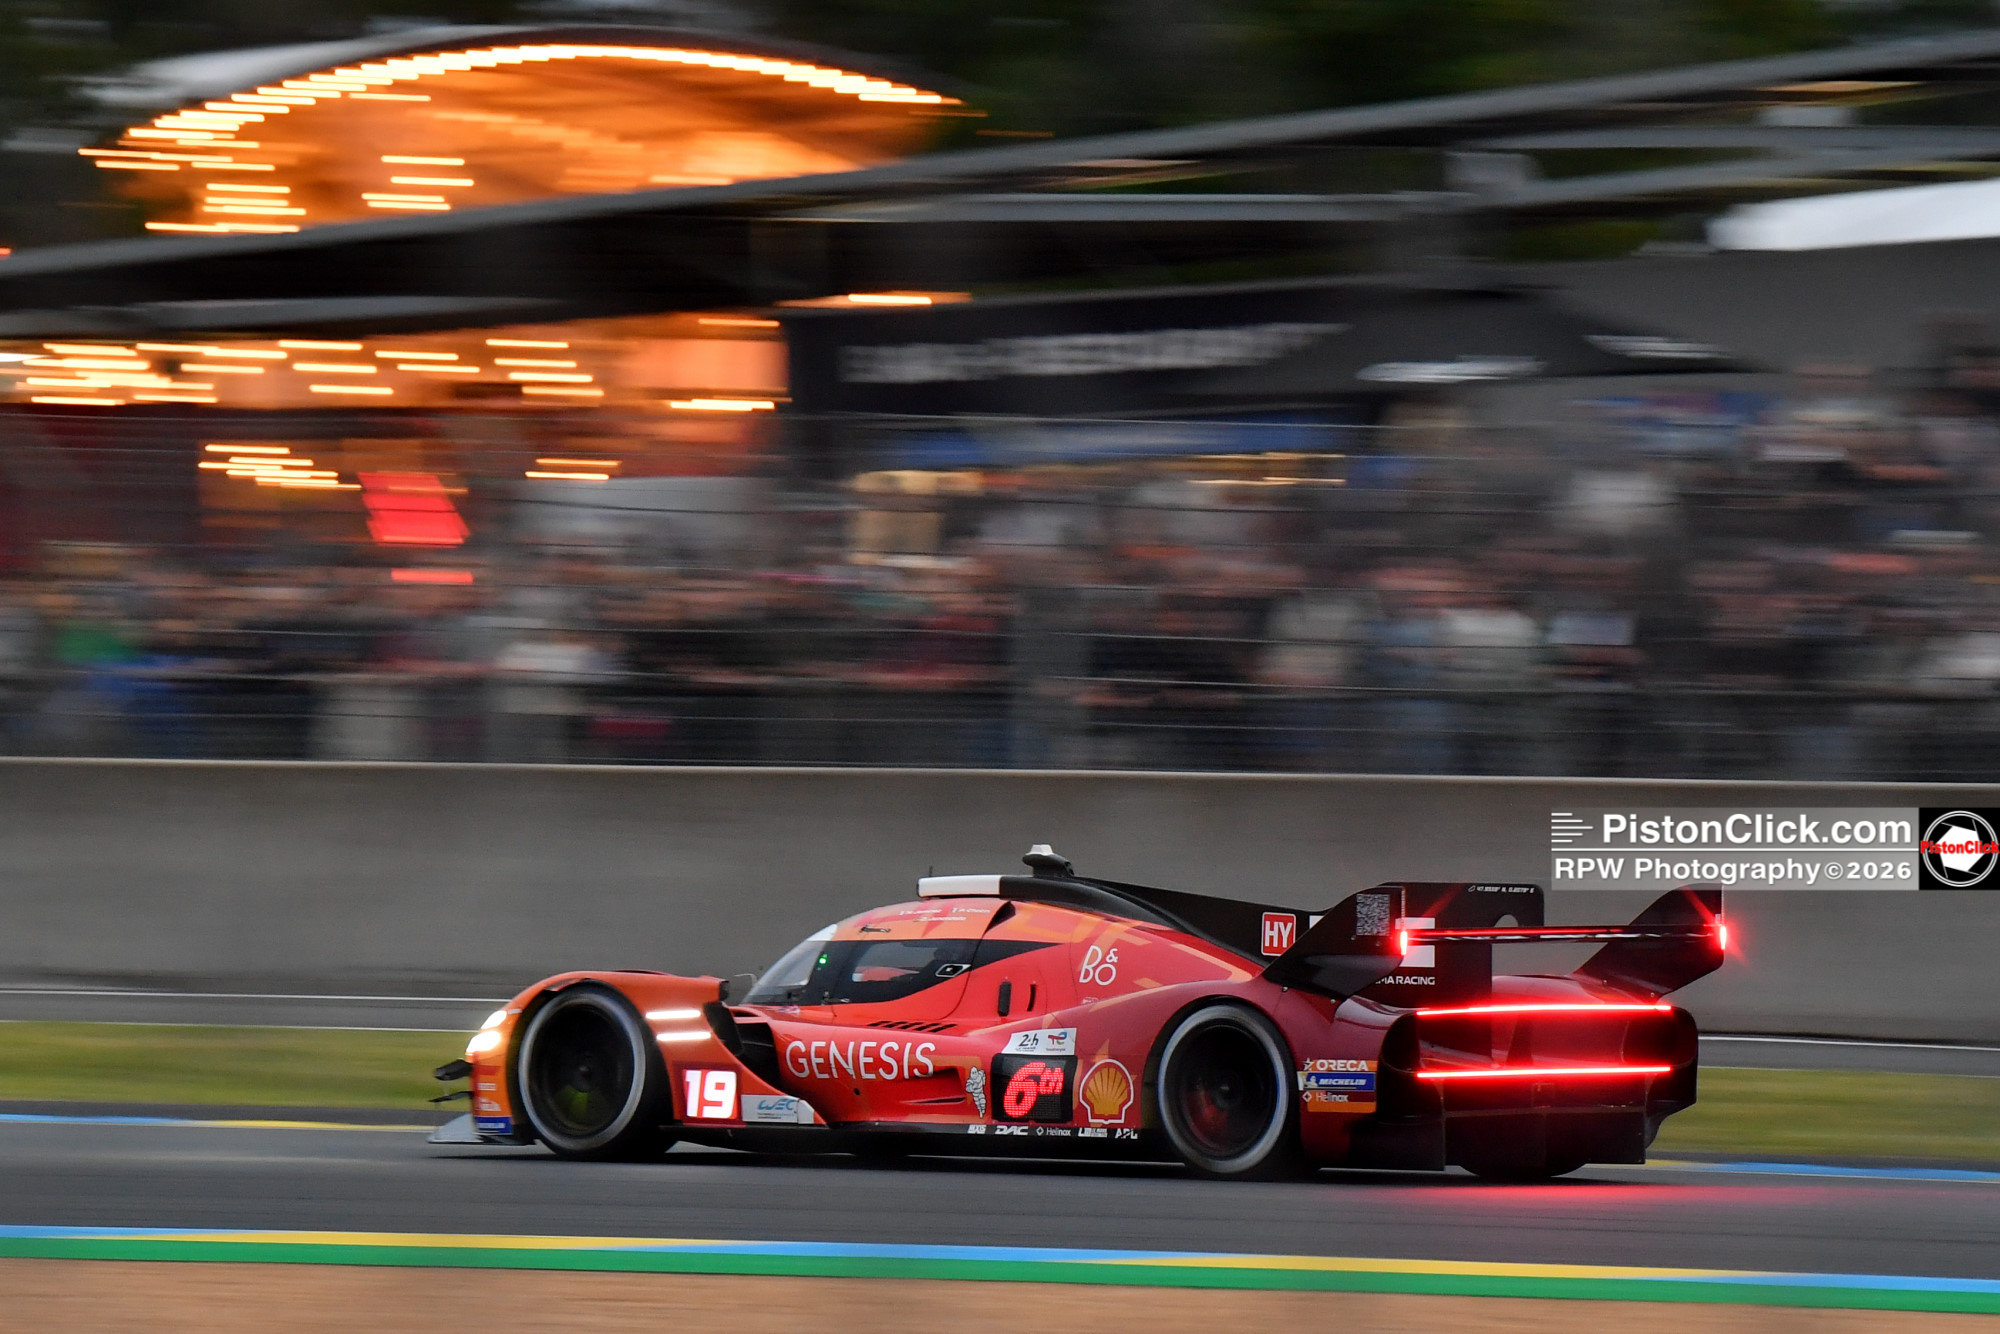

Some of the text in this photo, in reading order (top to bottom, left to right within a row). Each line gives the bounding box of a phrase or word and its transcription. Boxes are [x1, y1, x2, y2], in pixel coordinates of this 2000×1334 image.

[1264, 920, 1293, 948] HY
[1396, 976, 1436, 985] RACING
[786, 1040, 936, 1080] GENESIS
[1316, 1059, 1369, 1071] ORECA
[685, 1069, 737, 1119] 19
[994, 1125, 1029, 1136] DAC
